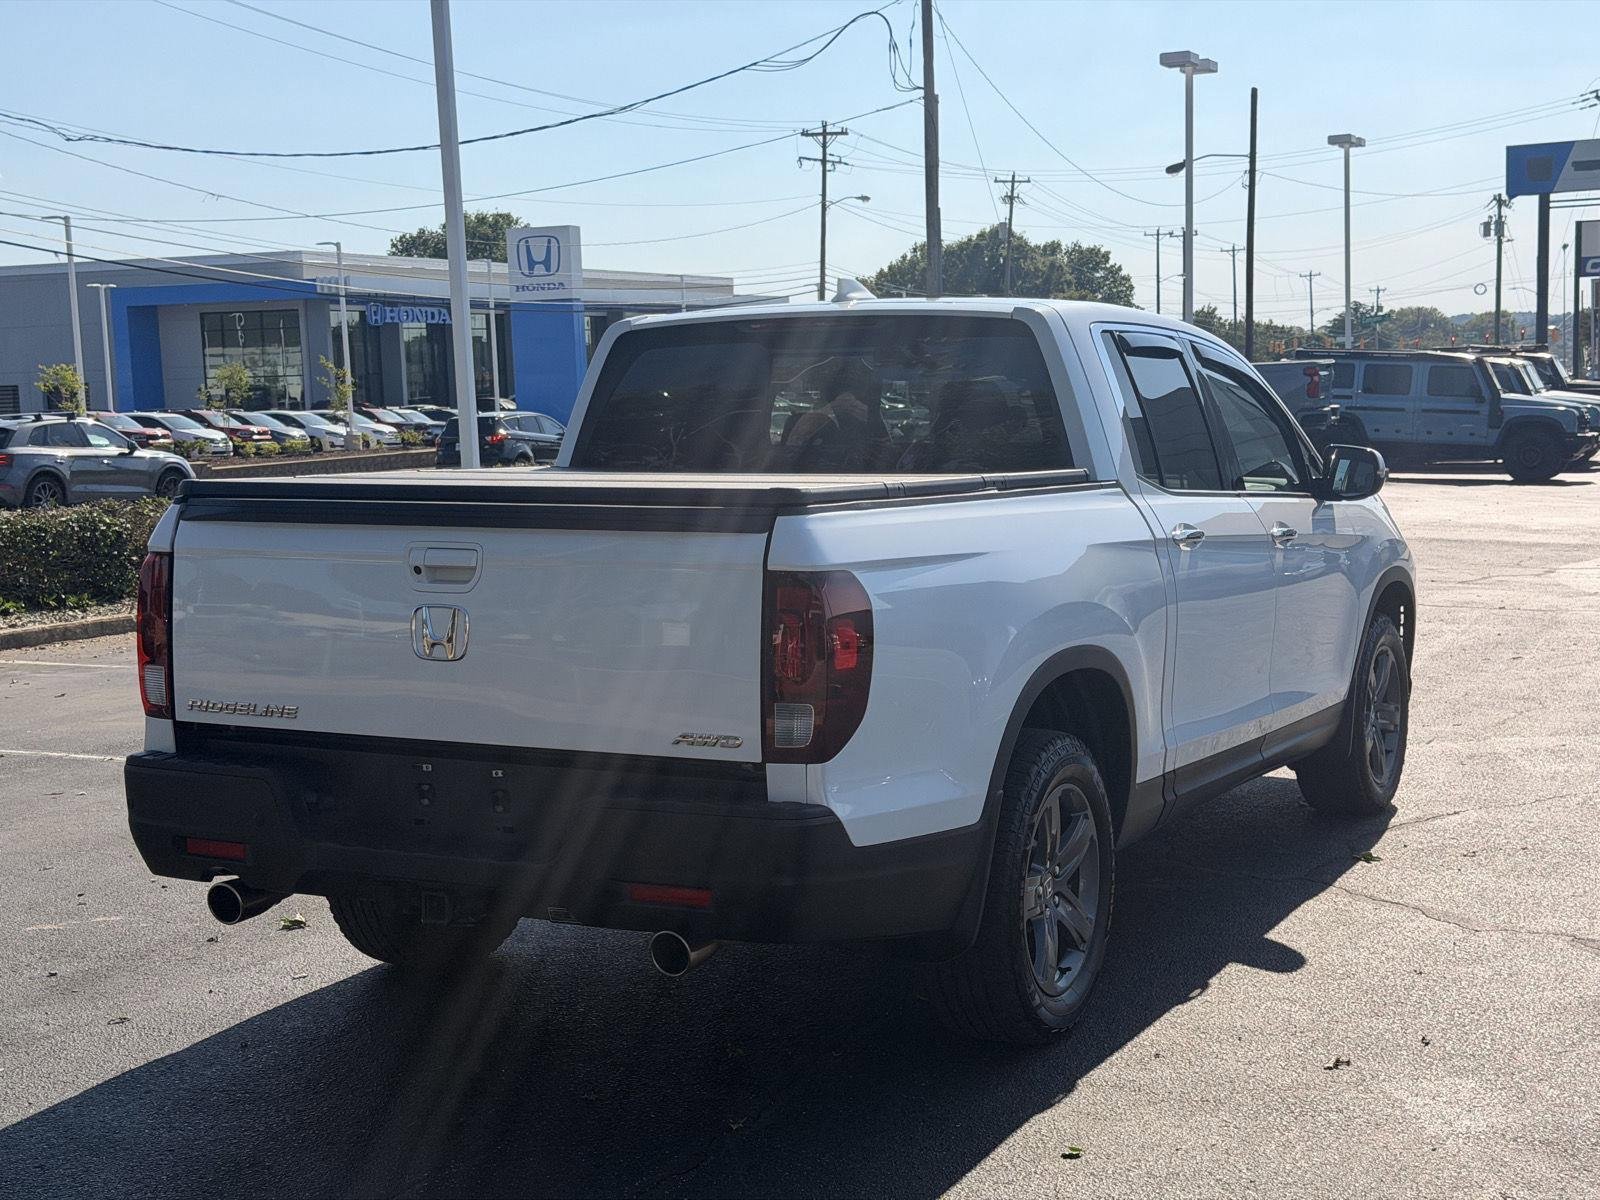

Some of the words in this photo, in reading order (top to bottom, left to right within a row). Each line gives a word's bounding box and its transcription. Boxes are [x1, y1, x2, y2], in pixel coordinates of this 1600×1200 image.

[515, 282, 566, 293] HONDA
[384, 306, 452, 324] HONDA
[187, 698, 299, 719] RIDGELINE
[671, 733, 744, 749] AWD
